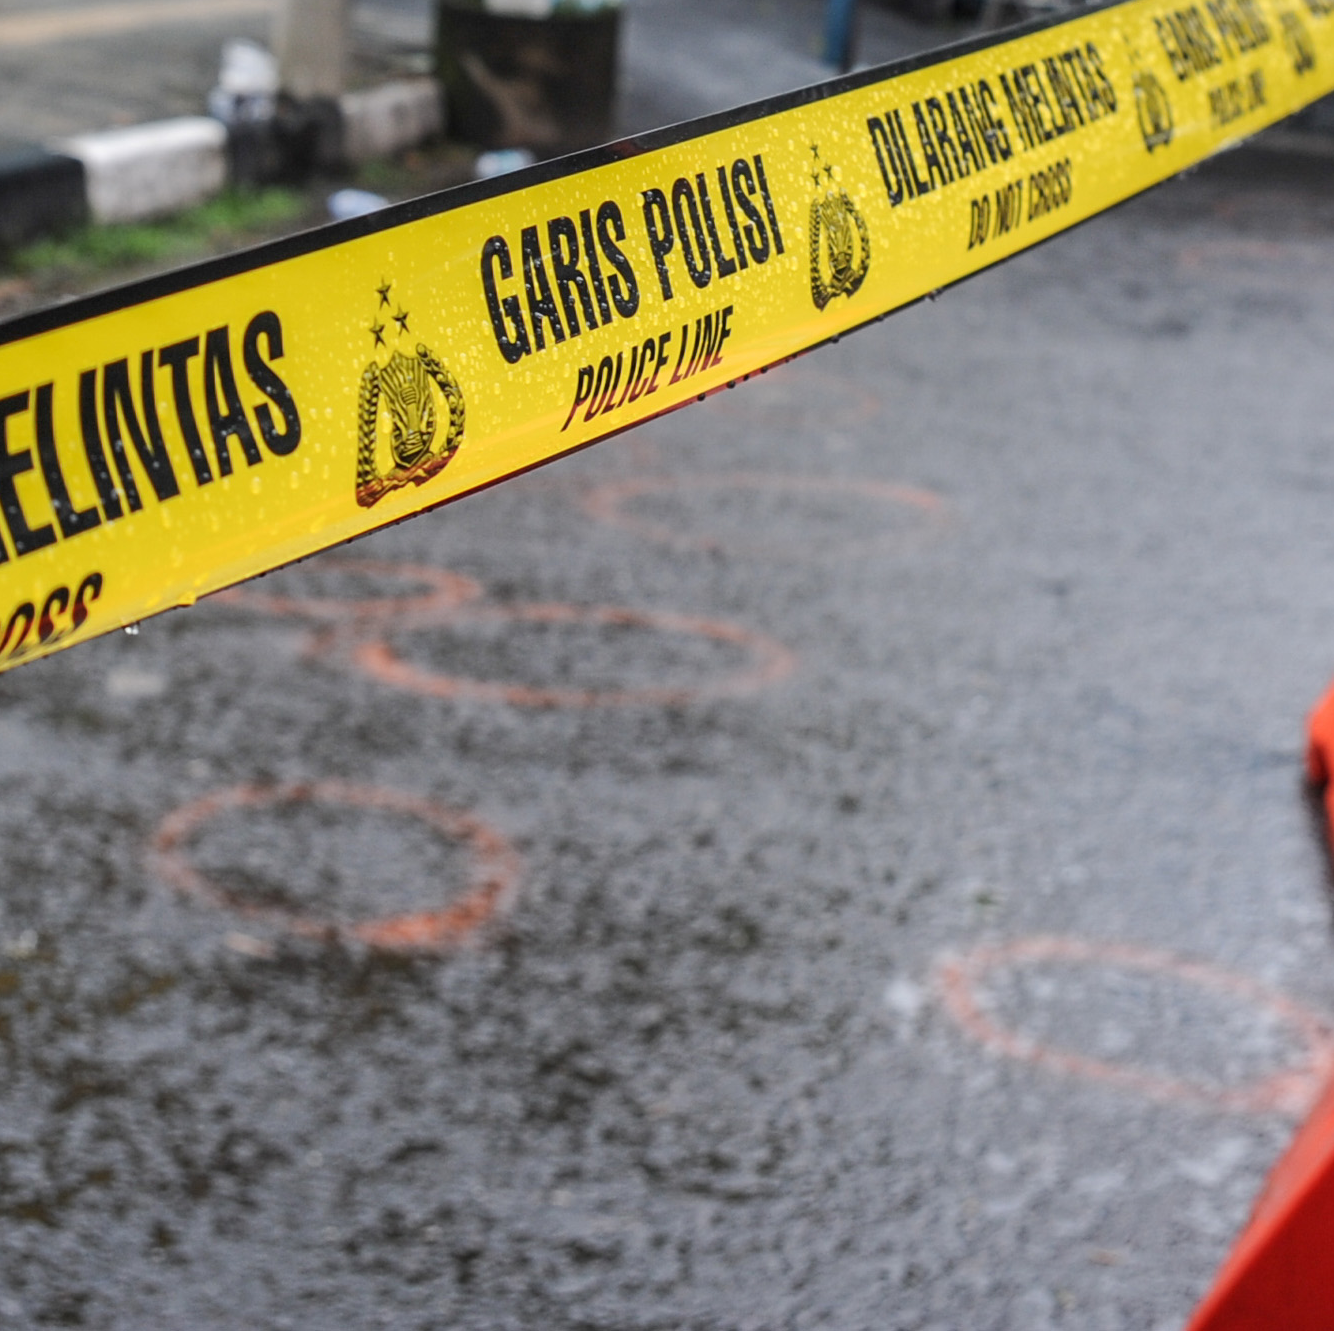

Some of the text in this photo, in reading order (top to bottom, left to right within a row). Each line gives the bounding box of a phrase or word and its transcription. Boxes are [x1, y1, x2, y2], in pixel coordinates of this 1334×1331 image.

[867, 79, 1013, 208] DILARANG
[998, 41, 1118, 152] MELINTAS
[480, 154, 785, 365] GARIS POLISI
[967, 194, 991, 251] DO
[993, 179, 1023, 240] NOT
[560, 304, 734, 433] POLICE LINE
